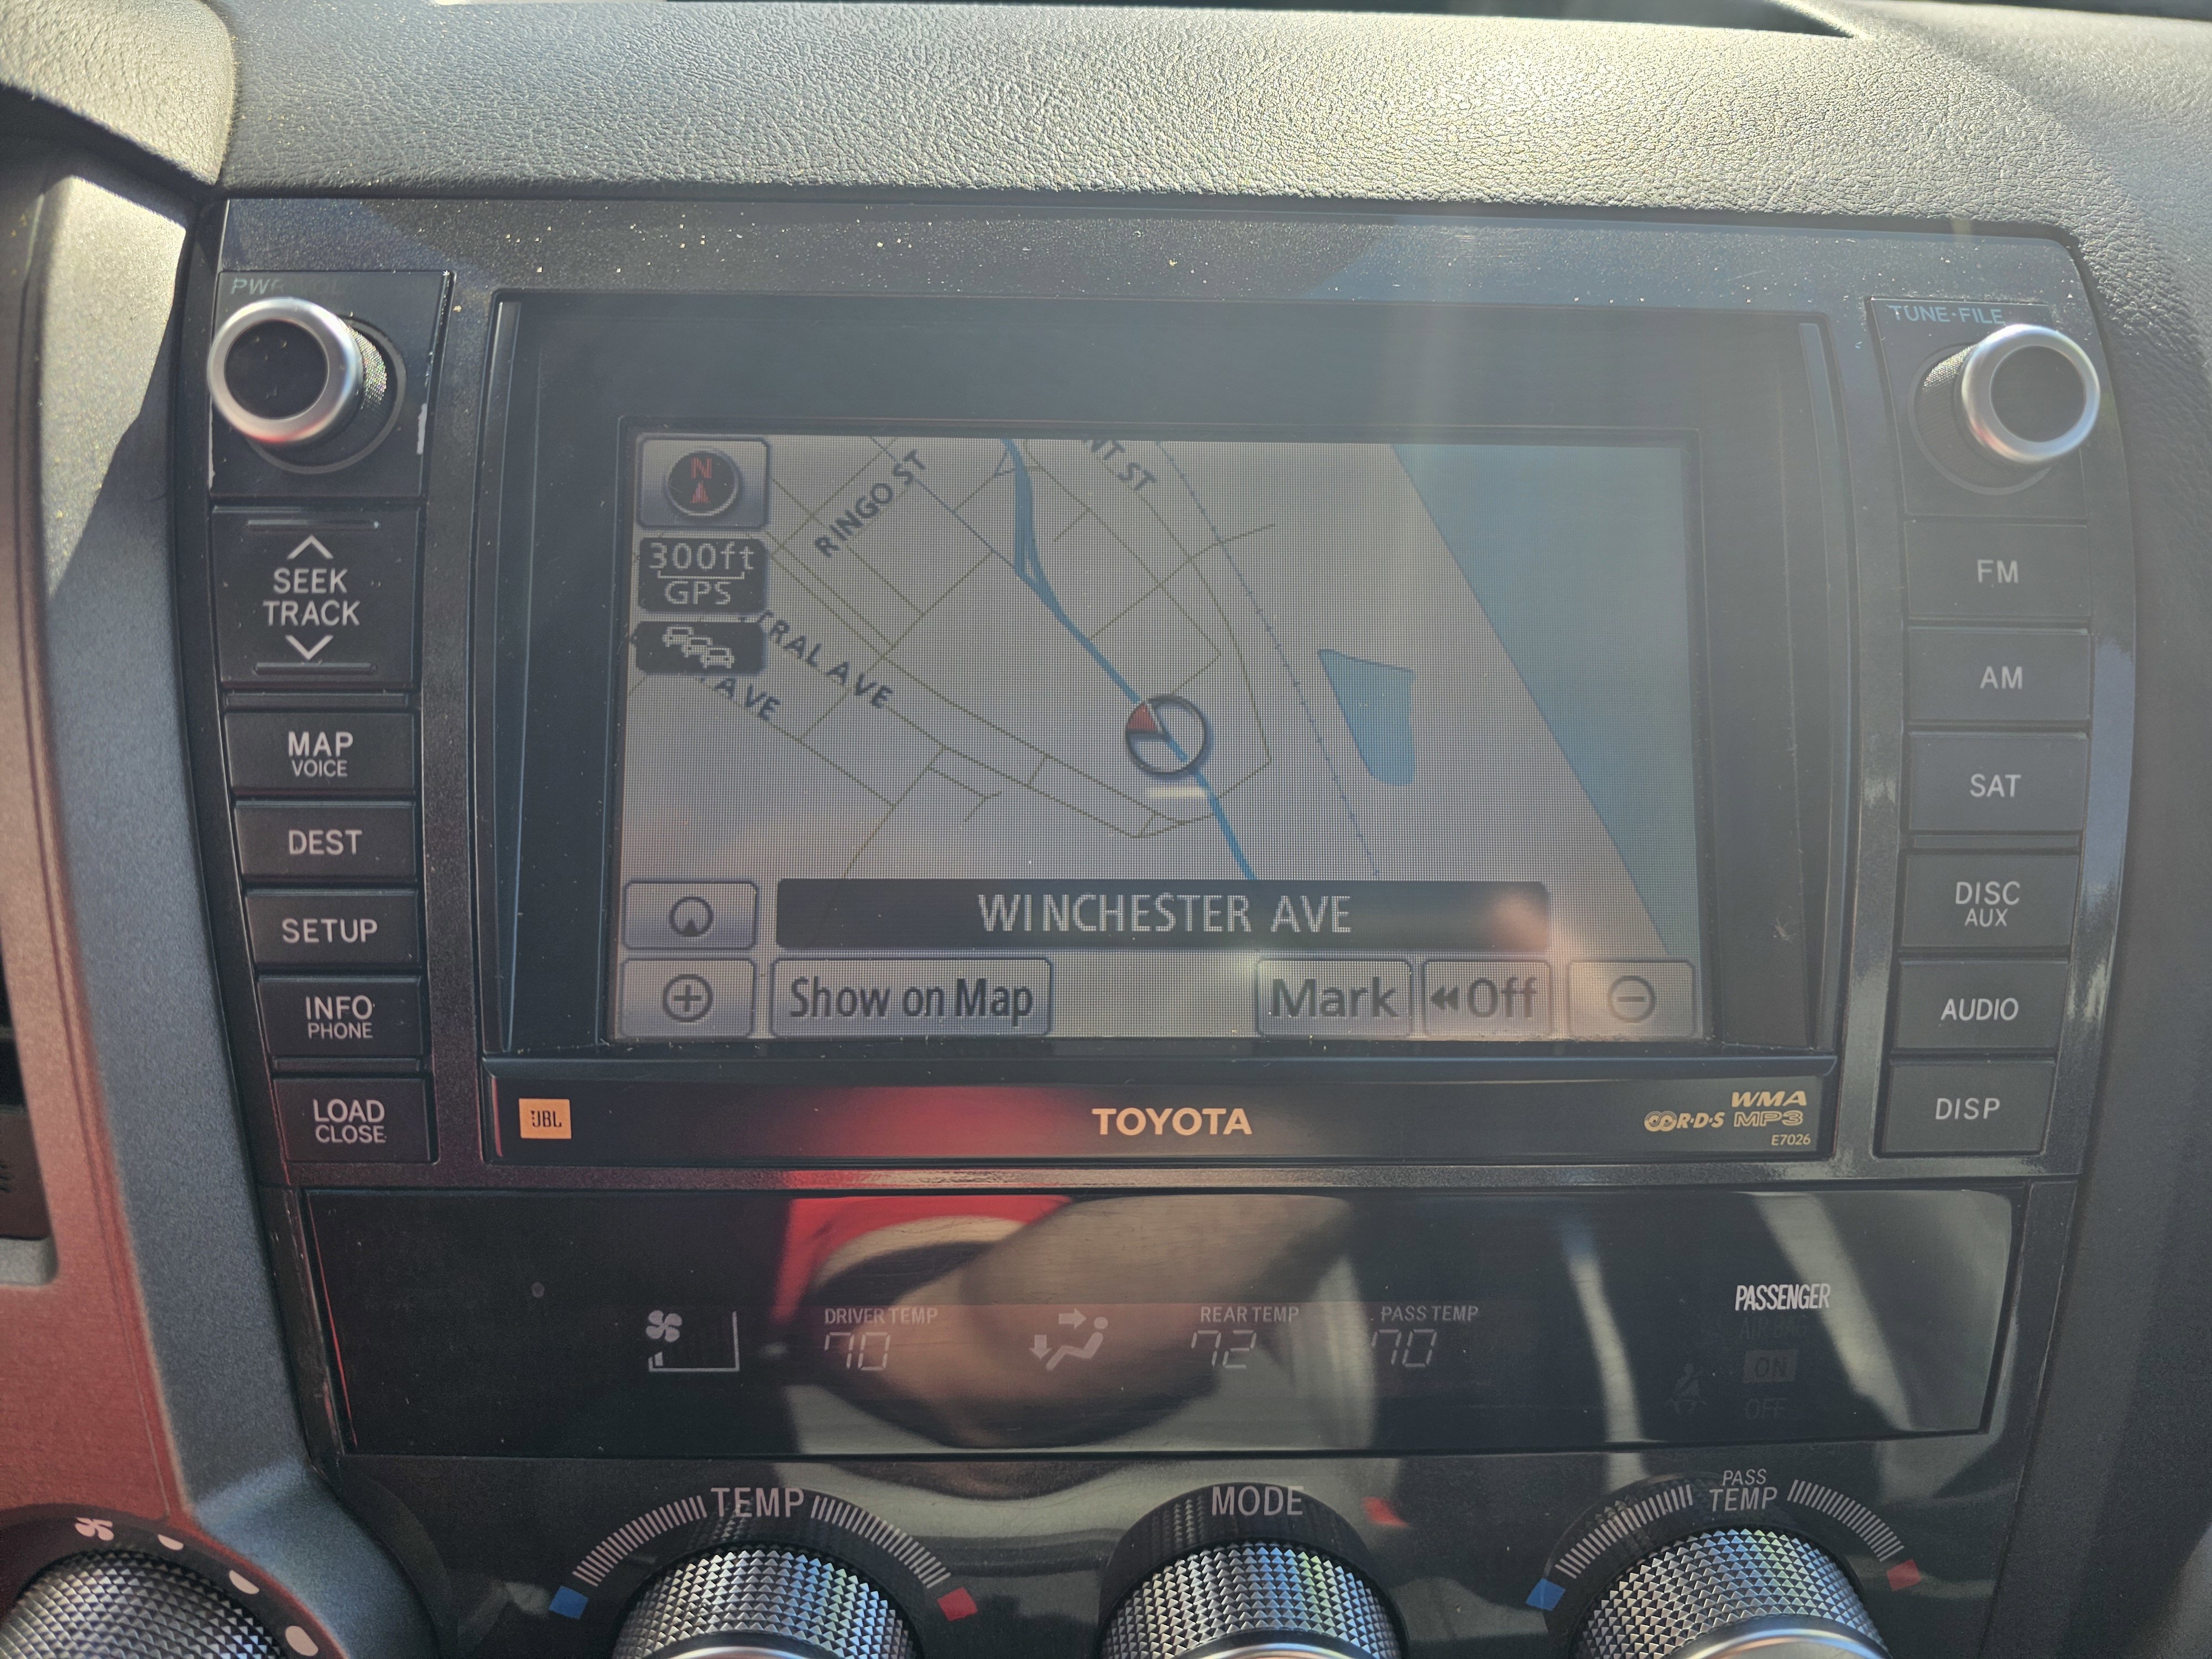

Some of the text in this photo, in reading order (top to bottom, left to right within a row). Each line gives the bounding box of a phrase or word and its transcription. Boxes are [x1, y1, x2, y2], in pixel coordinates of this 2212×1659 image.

[690, 457, 713, 479] N
[1117, 462, 1157, 491] ST
[815, 449, 927, 559] RINGO ST
[649, 541, 754, 570] 300ft
[273, 568, 348, 594] SEEK
[1977, 559, 2019, 584] FM
[664, 581, 731, 605] GPS
[263, 600, 361, 627] TRACK
[826, 661, 894, 709] AVE
[1979, 666, 2023, 690] AM
[713, 677, 780, 720] AVE
[288, 731, 354, 758] MAP
[291, 759, 348, 777] VOICE
[1969, 773, 2022, 797] SAT
[289, 829, 363, 855] DEST
[1955, 881, 2021, 905] DISC
[978, 893, 1352, 933] WINCHESTER AVE
[1964, 908, 2009, 927] AUX
[282, 919, 378, 943] SETUP
[305, 995, 373, 1021] INFO
[790, 975, 1034, 1027] Show on Map
[1270, 977, 1398, 1019] Mark
[1467, 976, 1538, 1020] Off
[1940, 998, 2020, 1021] AUDIO
[307, 1021, 373, 1039] PHONE
[313, 1098, 385, 1124] LOAD
[1731, 1090, 1807, 1108] WMA
[1935, 1097, 2001, 1120] DISP
[1092, 1107, 1253, 1136] TOYOTA
[1733, 1110, 1804, 1128] MP3
[315, 1125, 385, 1144] CLOSE
[1771, 1134, 1812, 1146] E7026
[1735, 1283, 1832, 1311] PASSENGER
[825, 1307, 938, 1325] DRIVER TEMP
[1200, 1306, 1300, 1323] REAR TEMP
[1380, 1305, 1479, 1322] PASS TEMP
[825, 1332, 891, 1371] 70
[1191, 1329, 1257, 1369] 72
[1371, 1329, 1437, 1369] 70
[1755, 1356, 1788, 1378] ON
[1745, 1397, 1788, 1421] OFF
[1722, 1468, 1767, 1486] PASS
[711, 1486, 805, 1518] TEMP
[1211, 1485, 1305, 1516] MODE
[1709, 1486, 1779, 1512] TEMP
